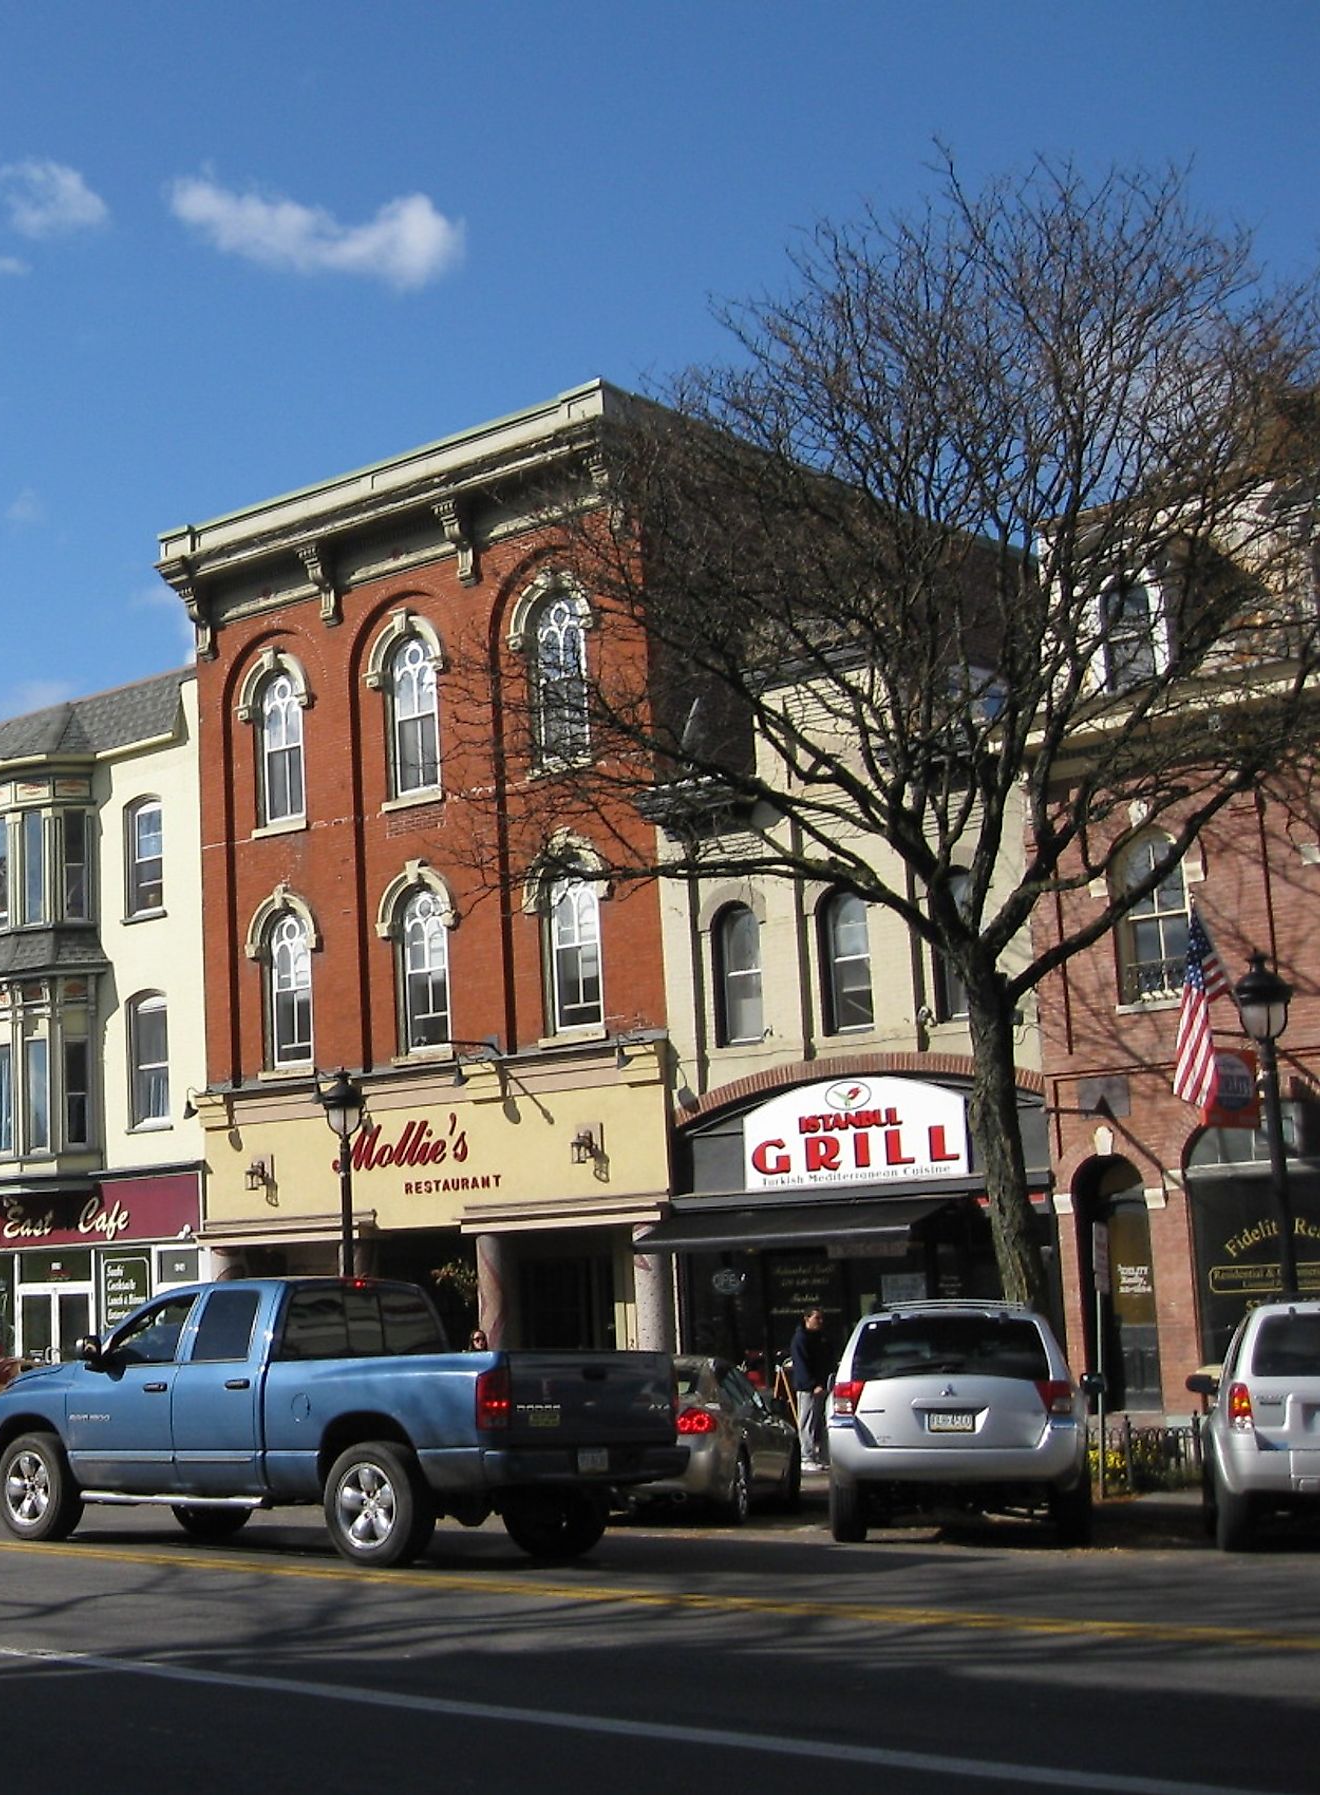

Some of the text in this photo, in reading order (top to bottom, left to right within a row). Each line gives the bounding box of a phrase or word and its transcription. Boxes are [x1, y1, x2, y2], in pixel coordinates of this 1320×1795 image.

[798, 1107, 903, 1134] ISTANBUL
[332, 1112, 468, 1172] Mollie's
[752, 1125, 960, 1175] GRILL
[404, 1174, 502, 1195] RESTAURANT
[762, 1164, 951, 1187] Turkish Mediterranean Cuisine
[3, 1196, 129, 1241] East Cafe
[1224, 1218, 1280, 1258] Fidelit
